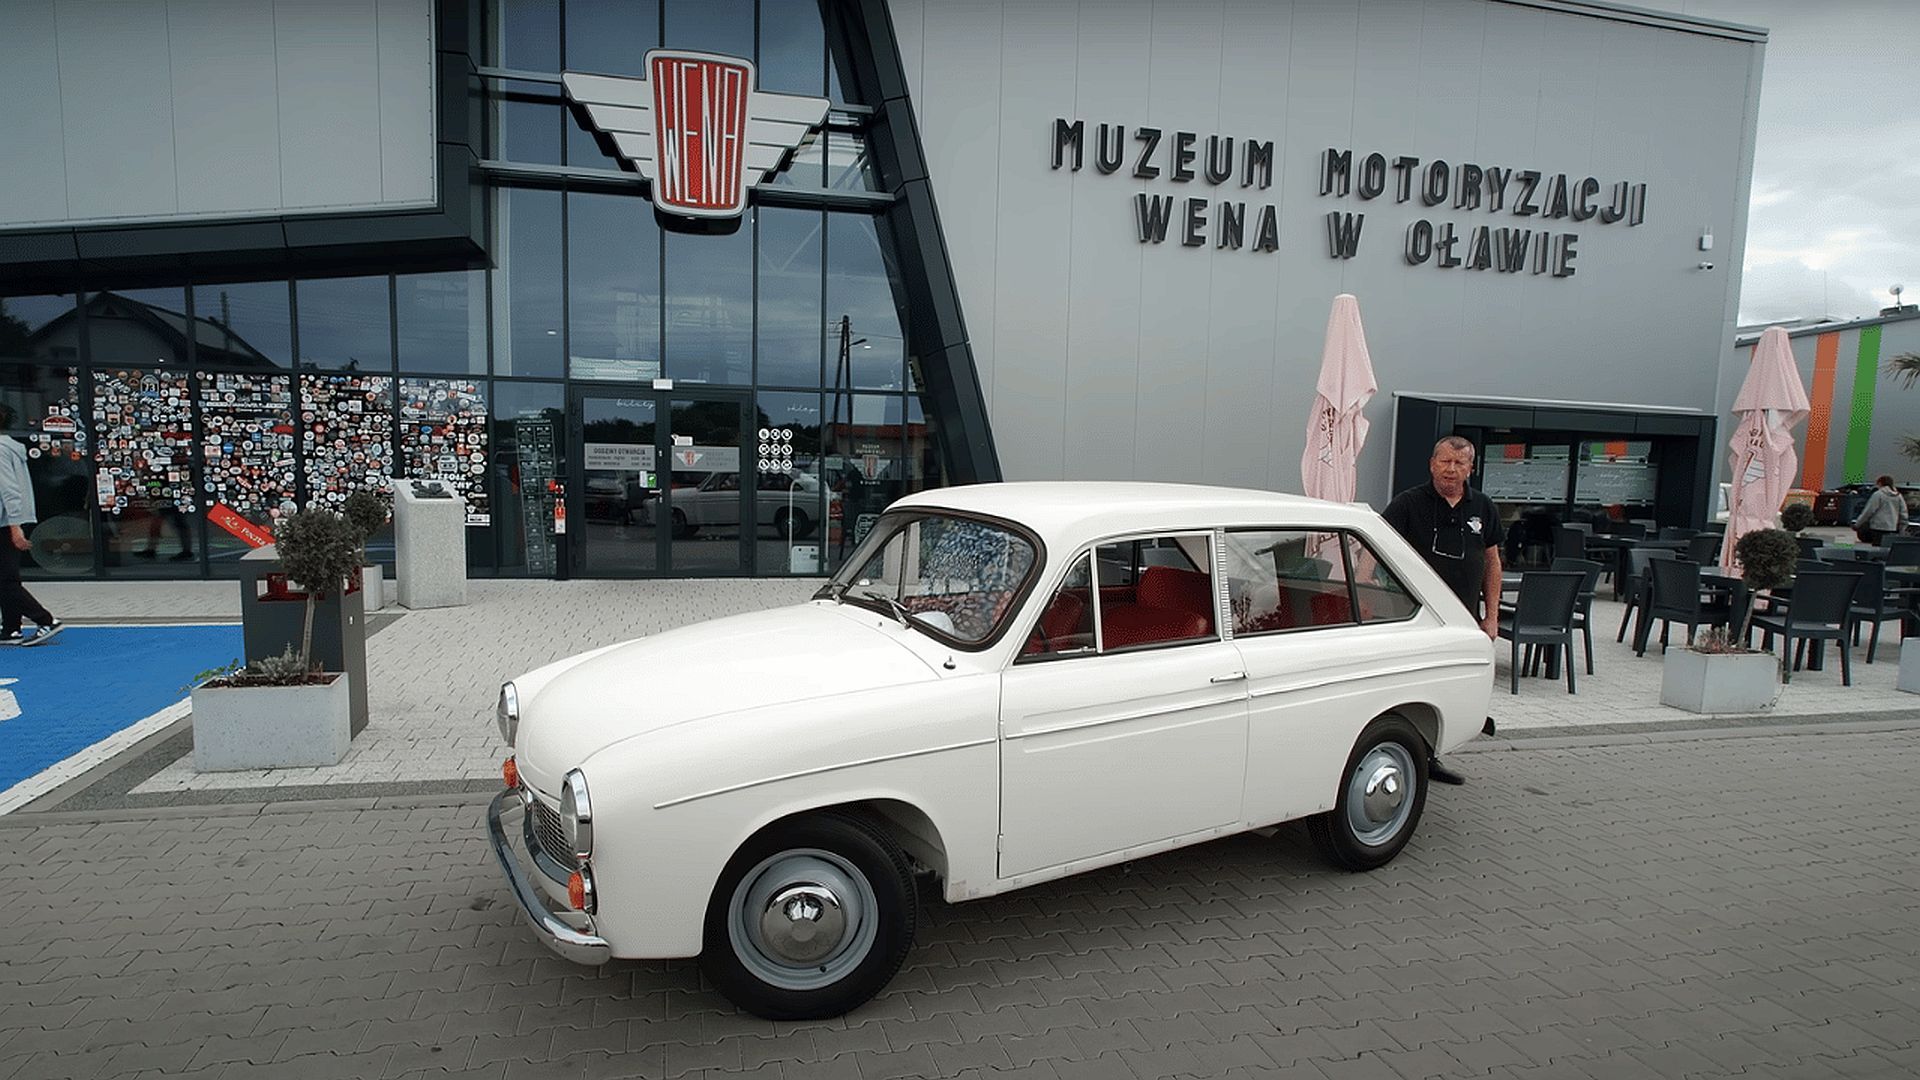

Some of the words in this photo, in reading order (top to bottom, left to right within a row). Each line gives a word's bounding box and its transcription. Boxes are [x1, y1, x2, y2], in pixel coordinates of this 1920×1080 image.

[658, 62, 741, 205] WENA
[1052, 118, 1274, 190] MUZEUM
[1319, 147, 1647, 227] MOTORYZACJI
[1134, 193, 1279, 253] WENA
[1327, 211, 1364, 259] W
[1405, 219, 1579, 278] OŁAWIE
